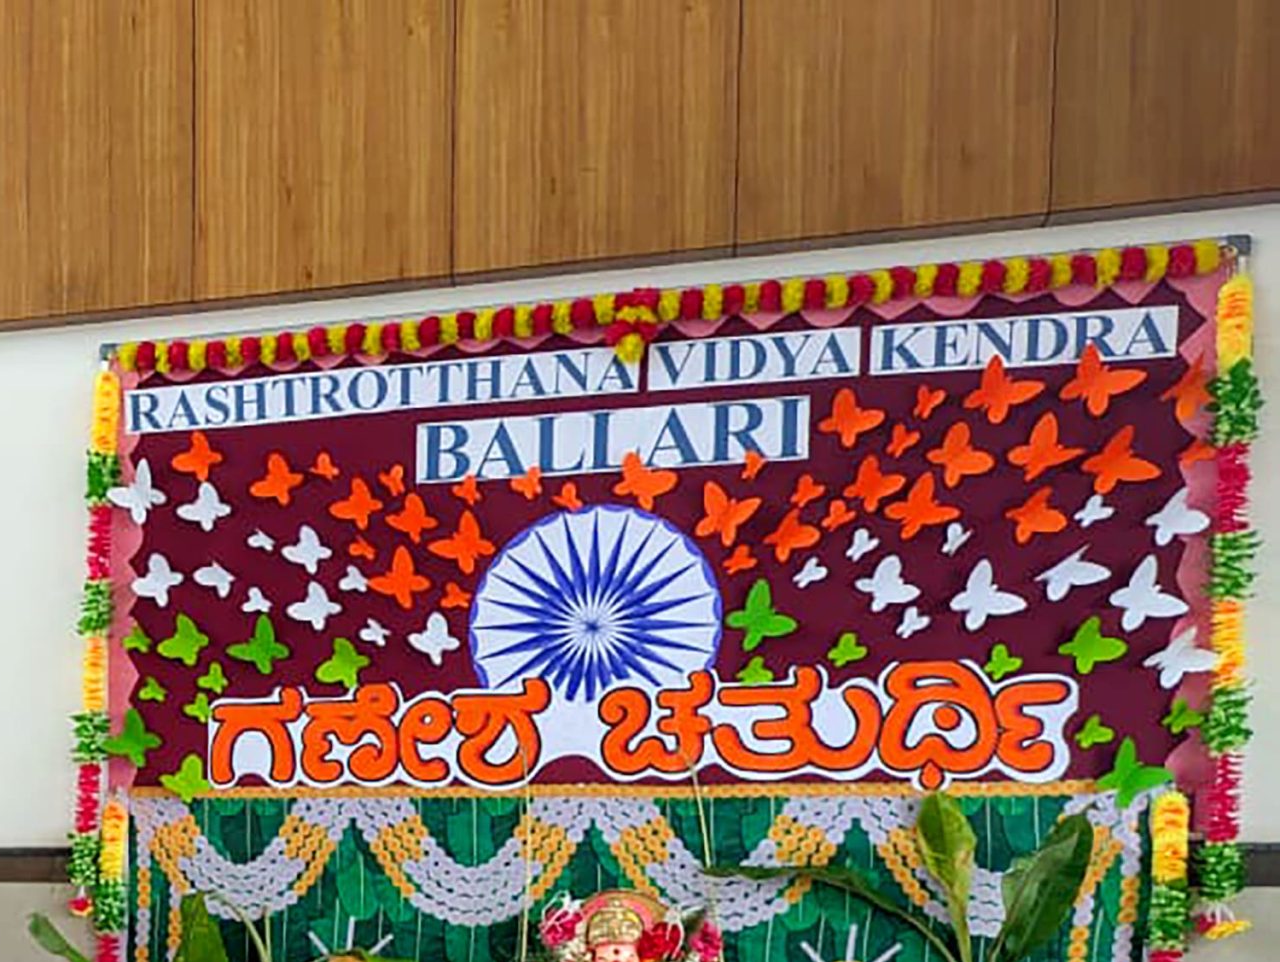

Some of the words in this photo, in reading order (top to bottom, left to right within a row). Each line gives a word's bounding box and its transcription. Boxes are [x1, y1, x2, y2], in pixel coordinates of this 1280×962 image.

[129, 351, 636, 431] RASHTROTTHANA
[655, 332, 853, 385] VIDYA
[877, 311, 1169, 371] KENDRA
[424, 399, 801, 480] BALLARI
[211, 676, 552, 784] ಗಣೇಶ
[598, 659, 1071, 789] ಚತುರ್ಥಿ
